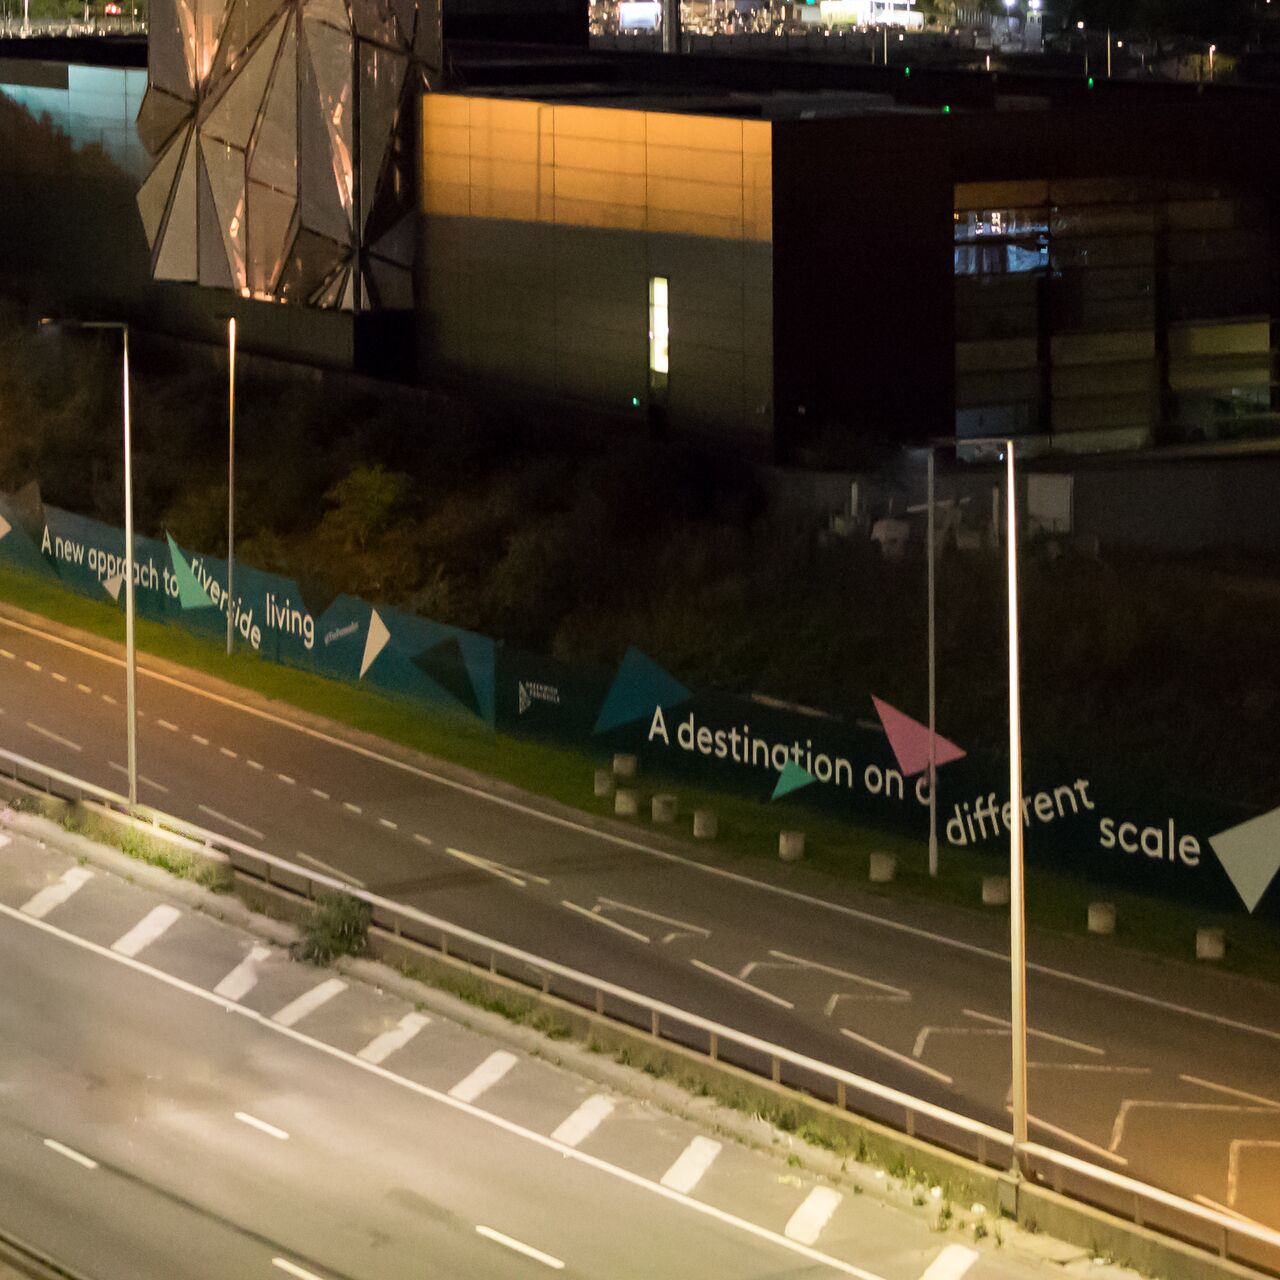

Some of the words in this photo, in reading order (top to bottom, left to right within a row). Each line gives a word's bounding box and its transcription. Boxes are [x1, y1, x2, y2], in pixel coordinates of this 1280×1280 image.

[41, 524, 52, 556] A
[55, 536, 85, 565] new
[162, 566, 179, 598] to
[266, 592, 315, 649] living
[648, 705, 669, 744] A
[678, 714, 852, 787] destination
[865, 761, 904, 800] on
[946, 778, 1096, 846] different
[1100, 817, 1201, 866] scale
